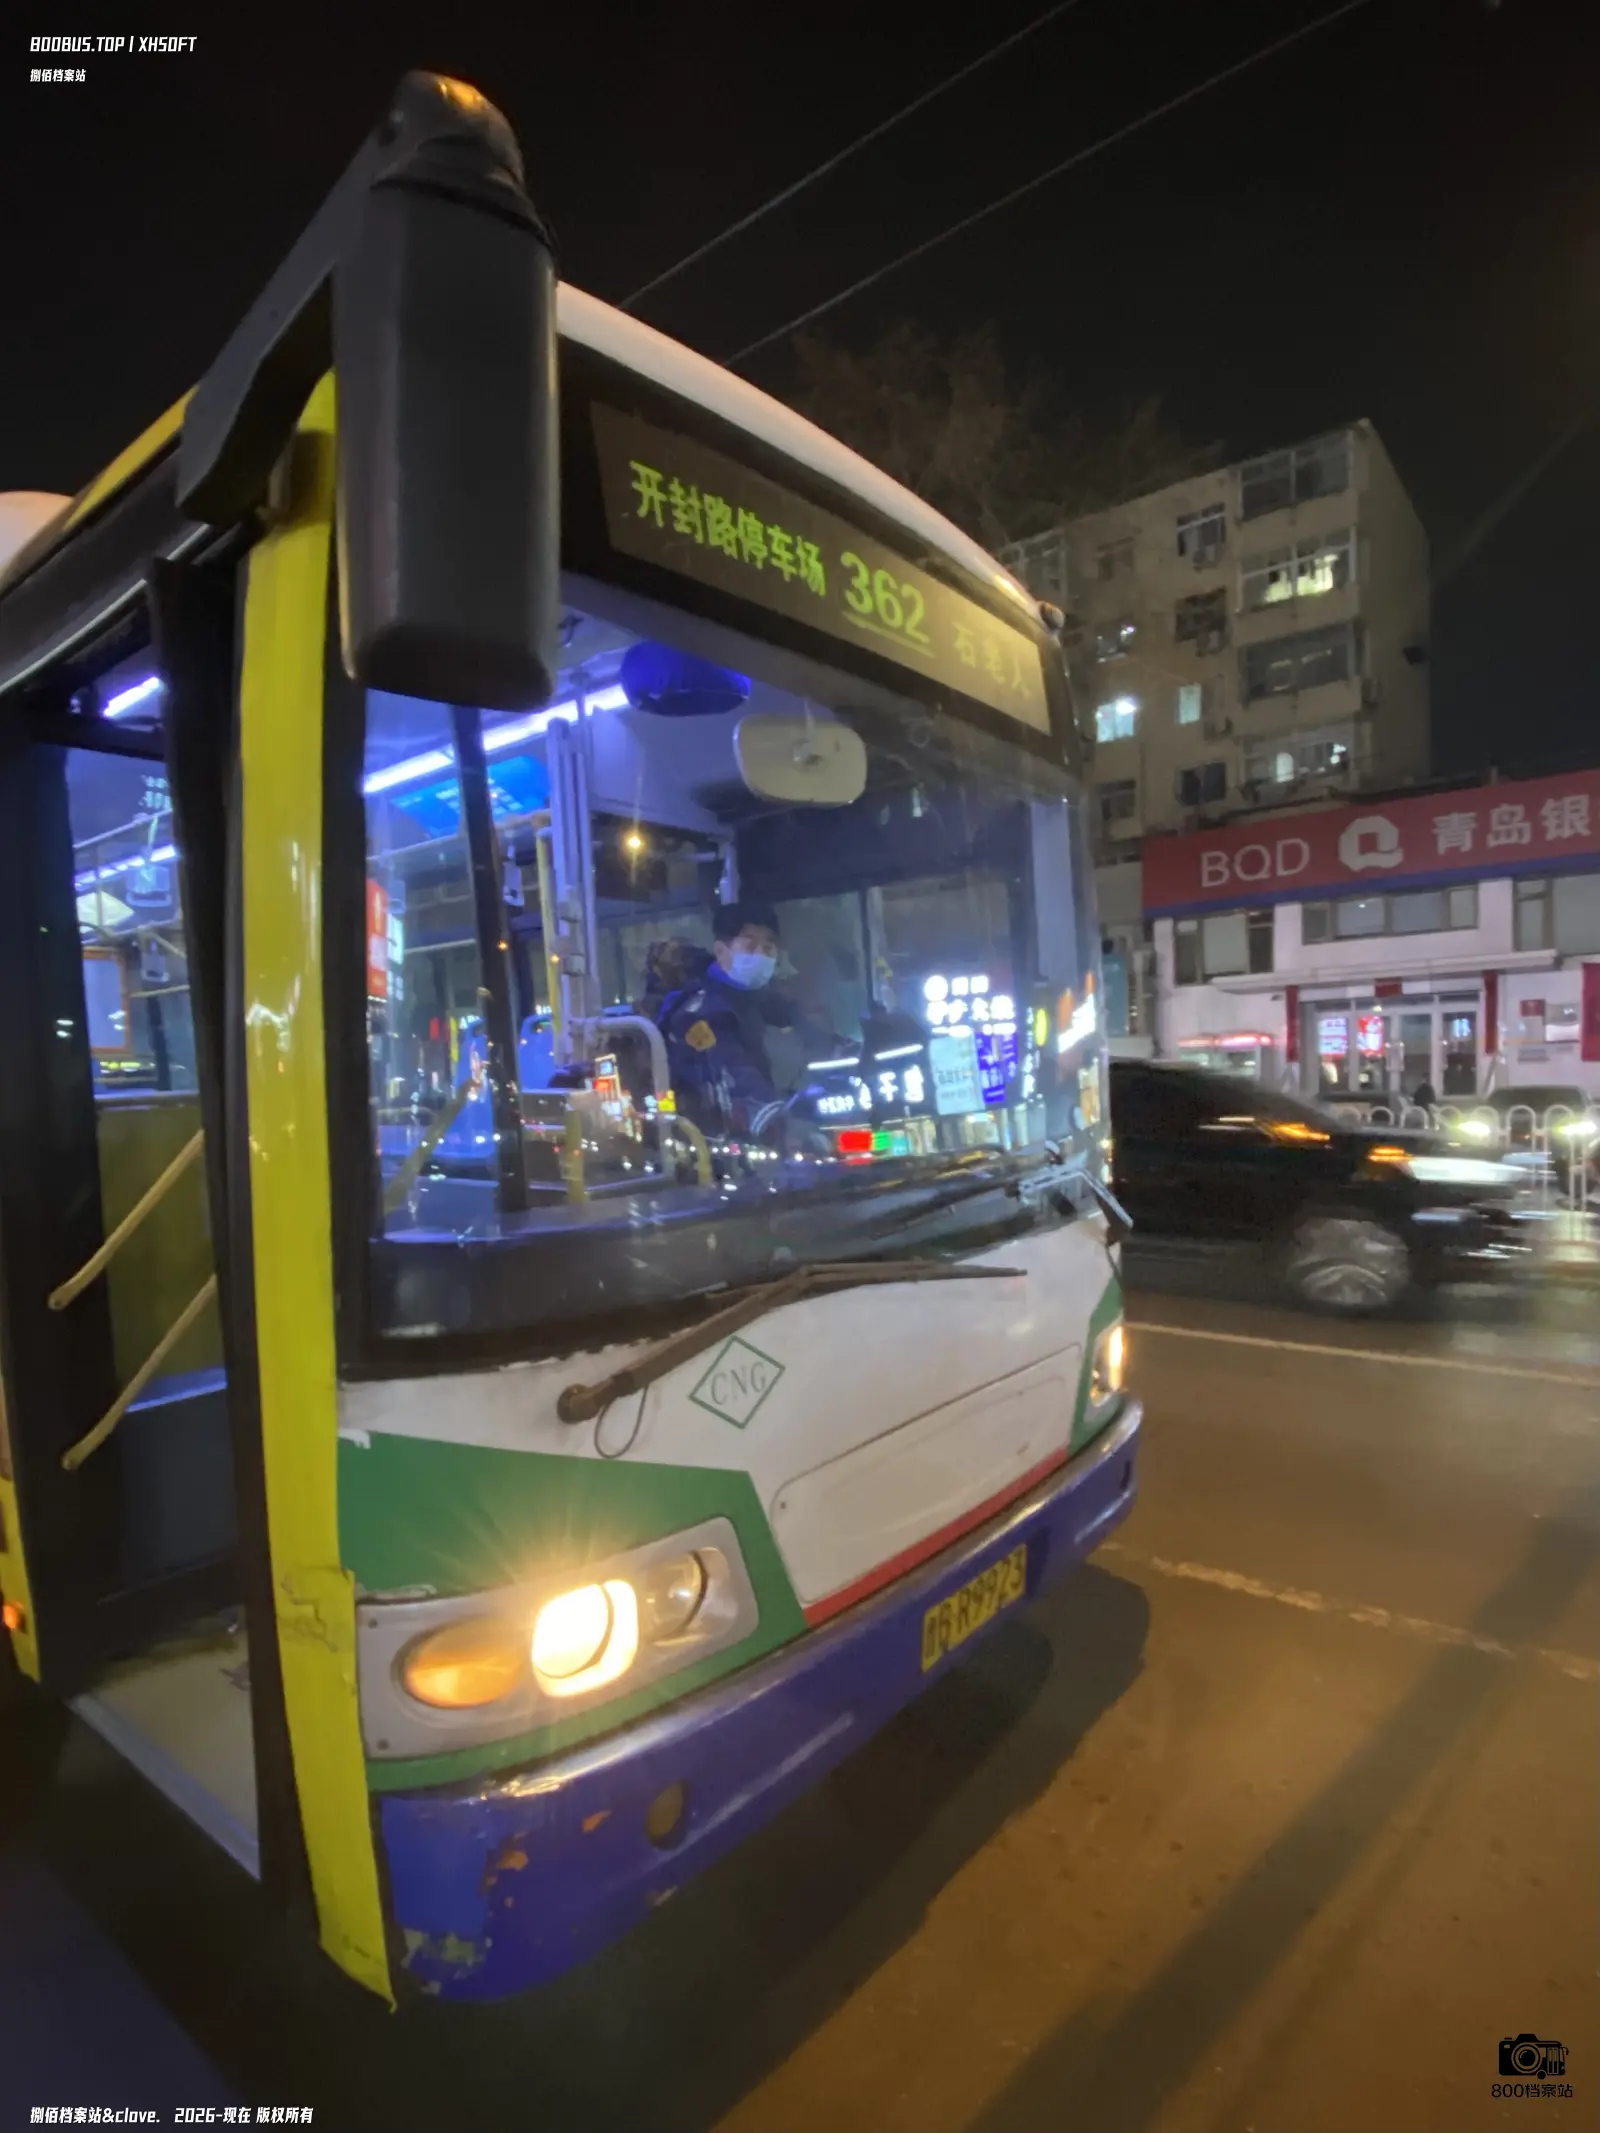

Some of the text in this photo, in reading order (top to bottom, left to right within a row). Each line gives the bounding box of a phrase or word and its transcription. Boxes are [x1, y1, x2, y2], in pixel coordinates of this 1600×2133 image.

[629, 460, 827, 597] 开封路停车场
[840, 551, 931, 645] 362
[1432, 794, 1600, 856] 青岛银
[1200, 838, 1310, 888] BQD
[711, 1361, 766, 1406] CNG
